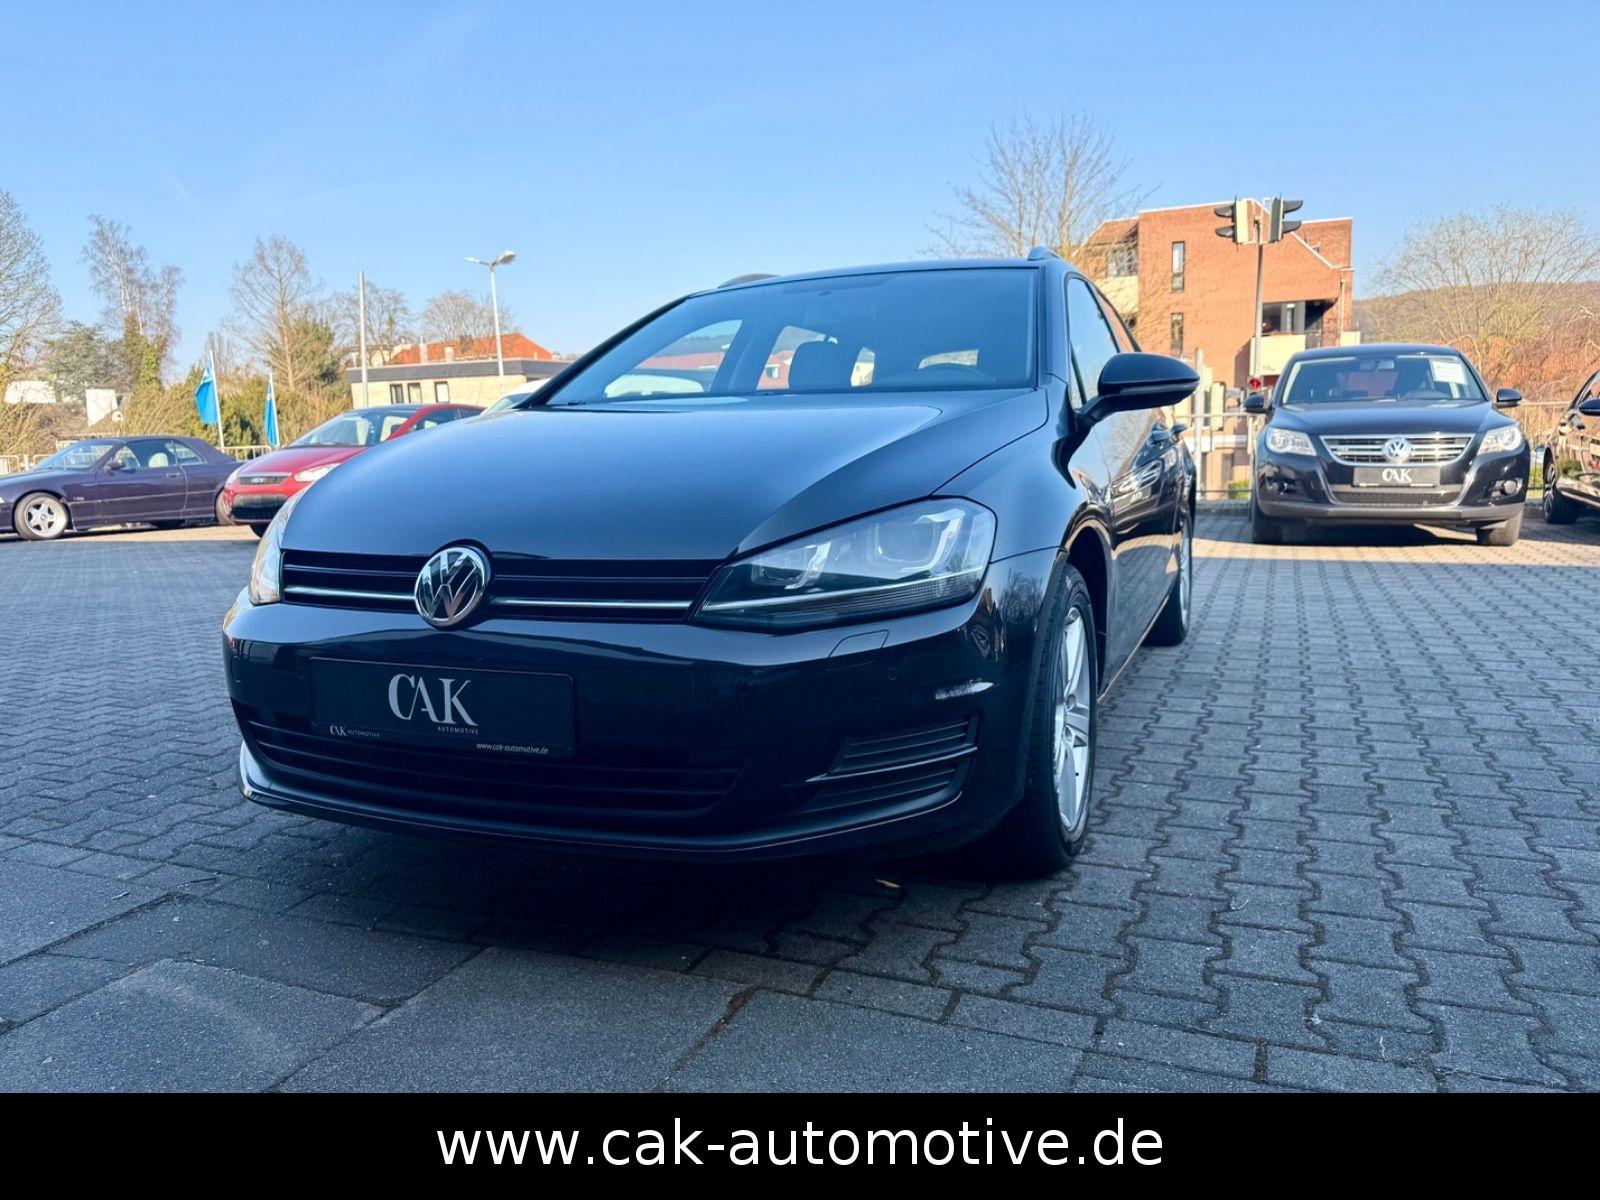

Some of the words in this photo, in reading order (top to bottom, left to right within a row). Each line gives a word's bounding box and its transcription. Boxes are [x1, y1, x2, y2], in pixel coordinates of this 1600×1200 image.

[1382, 468, 1413, 483] CAK
[388, 673, 479, 727] CAK
[329, 725, 347, 737] CAK
[347, 730, 381, 738] AUTOMOTIVE
[437, 726, 479, 735] AUTOMOTIVE
[476, 742, 549, 754] www.cak-automotive.de
